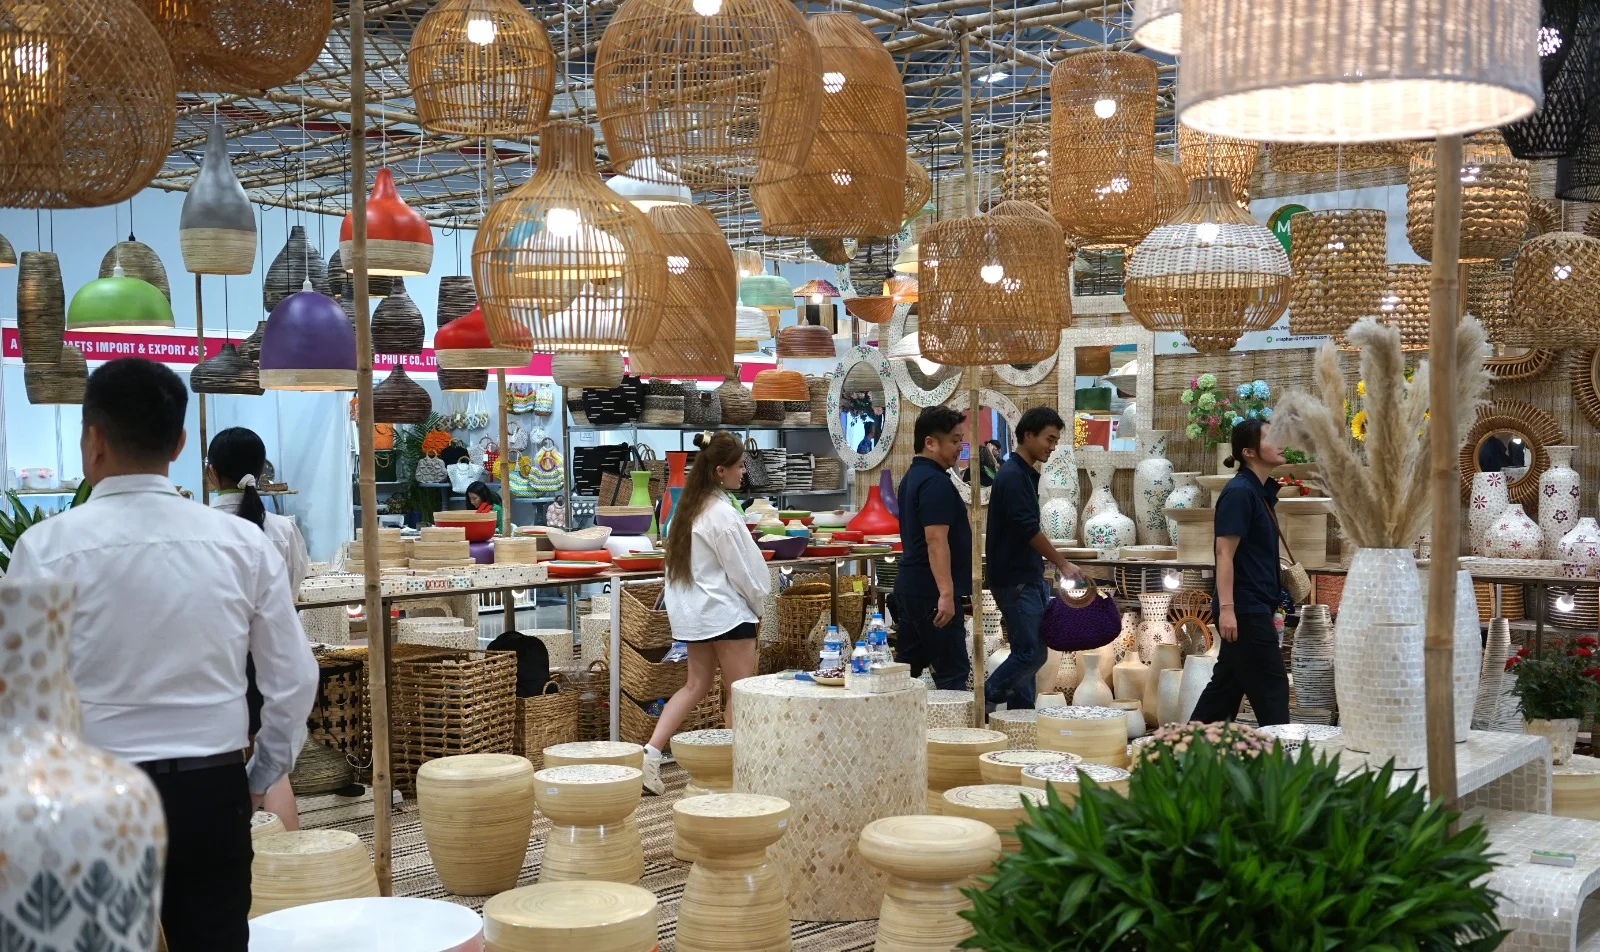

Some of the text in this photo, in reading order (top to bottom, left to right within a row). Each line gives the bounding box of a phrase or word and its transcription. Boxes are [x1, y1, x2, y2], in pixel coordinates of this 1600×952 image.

[95, 341, 135, 354] IMPORT
[137, 343, 146, 354] &
[148, 343, 186, 356] EXPORT
[381, 354, 398, 365] PHU
[399, 355, 408, 365] IE
[409, 355, 425, 367] CO.,
